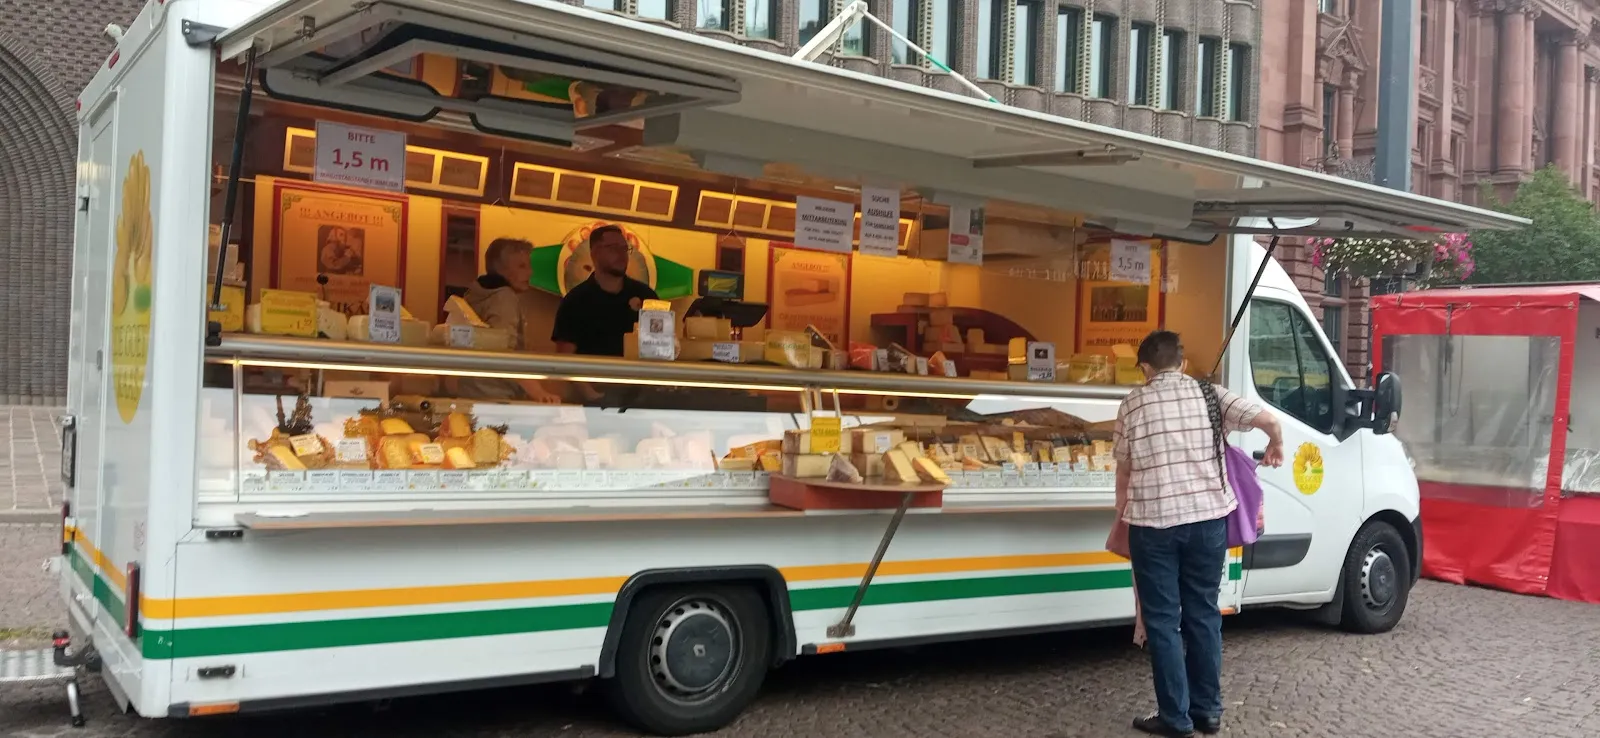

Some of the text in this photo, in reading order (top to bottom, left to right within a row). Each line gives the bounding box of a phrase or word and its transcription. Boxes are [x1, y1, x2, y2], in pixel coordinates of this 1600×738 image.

[347, 131, 376, 144] BITTE
[332, 148, 389, 172] 1,5 m
[315, 209, 369, 222] ANGEBOT
[866, 207, 894, 218] AUSHILFE
[1118, 256, 1132, 270] 1,5
[1135, 261, 1144, 270] m
